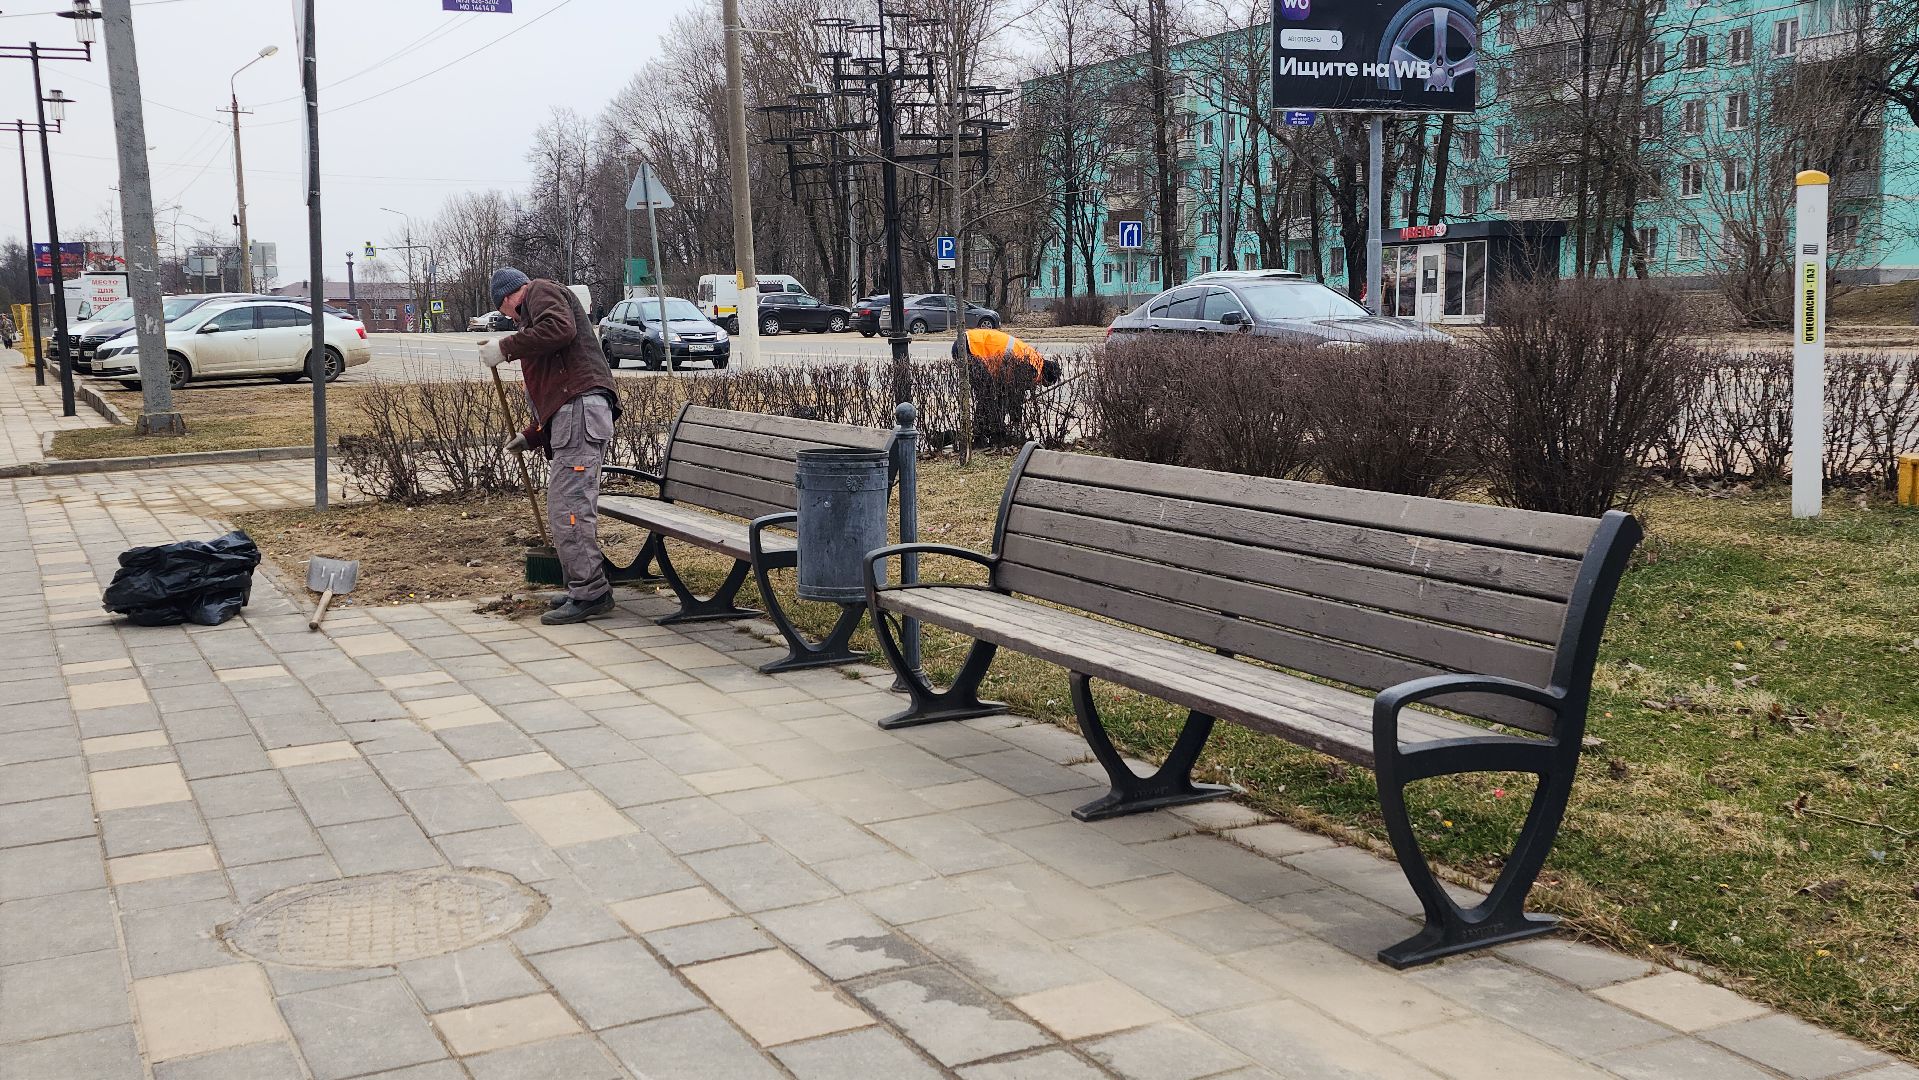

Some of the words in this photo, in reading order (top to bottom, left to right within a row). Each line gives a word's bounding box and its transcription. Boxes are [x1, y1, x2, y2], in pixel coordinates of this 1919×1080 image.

[1279, 57, 1359, 78] Ищите
[1363, 62, 1389, 78] на
[1394, 60, 1432, 79] WB
[1400, 225, 1436, 240] ЦВЕТЫ
[942, 240, 953, 256] P
[1805, 289, 1815, 342] ОГНЕОПАСНО
